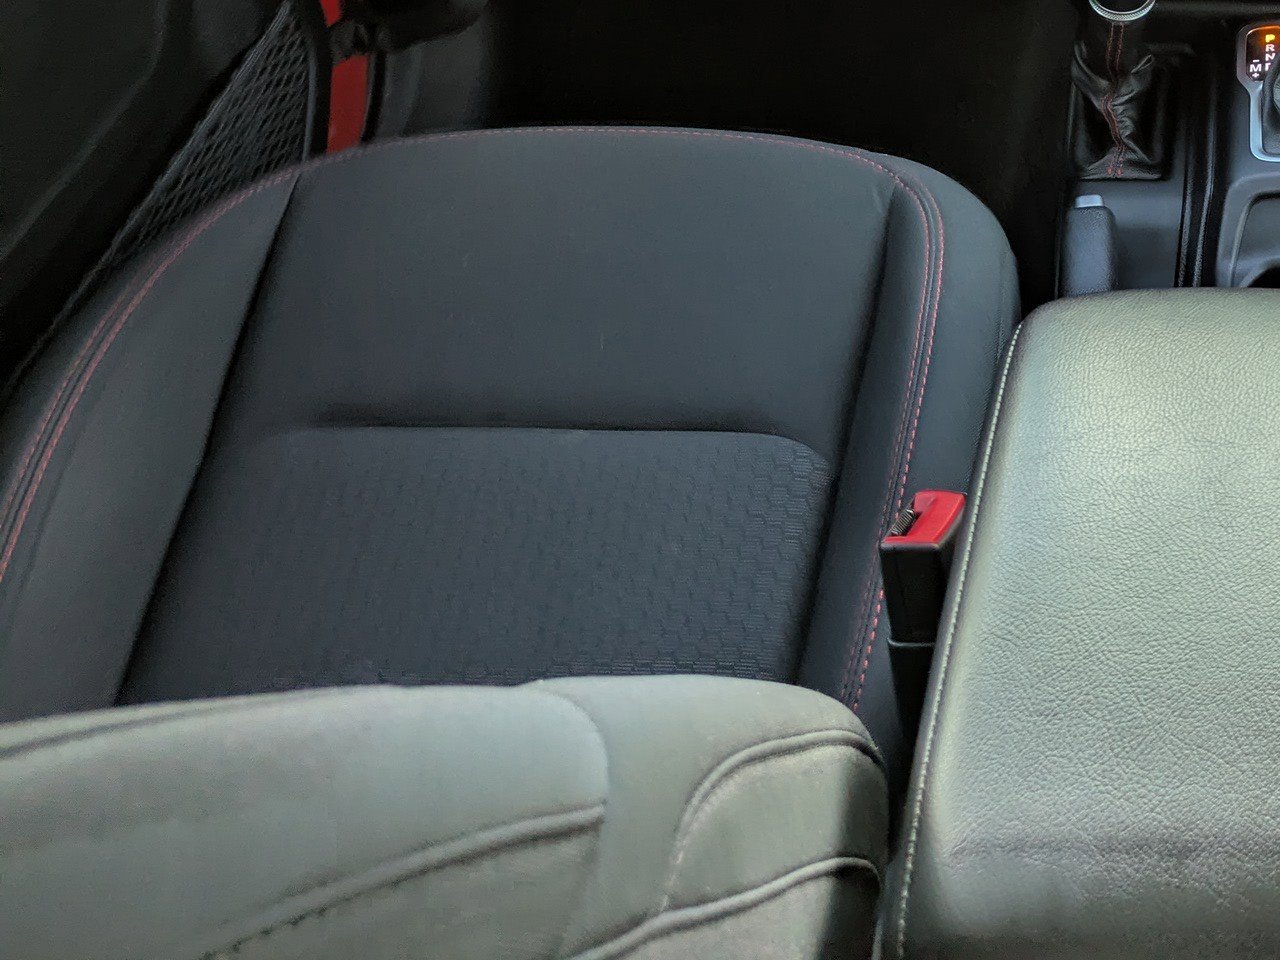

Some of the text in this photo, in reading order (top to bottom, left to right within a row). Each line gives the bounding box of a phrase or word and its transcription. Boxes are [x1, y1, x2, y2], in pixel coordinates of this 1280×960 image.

[1264, 34, 1276, 43] P
[1265, 43, 1275, 52] R
[1265, 52, 1276, 61] N
[1249, 63, 1262, 73] M
